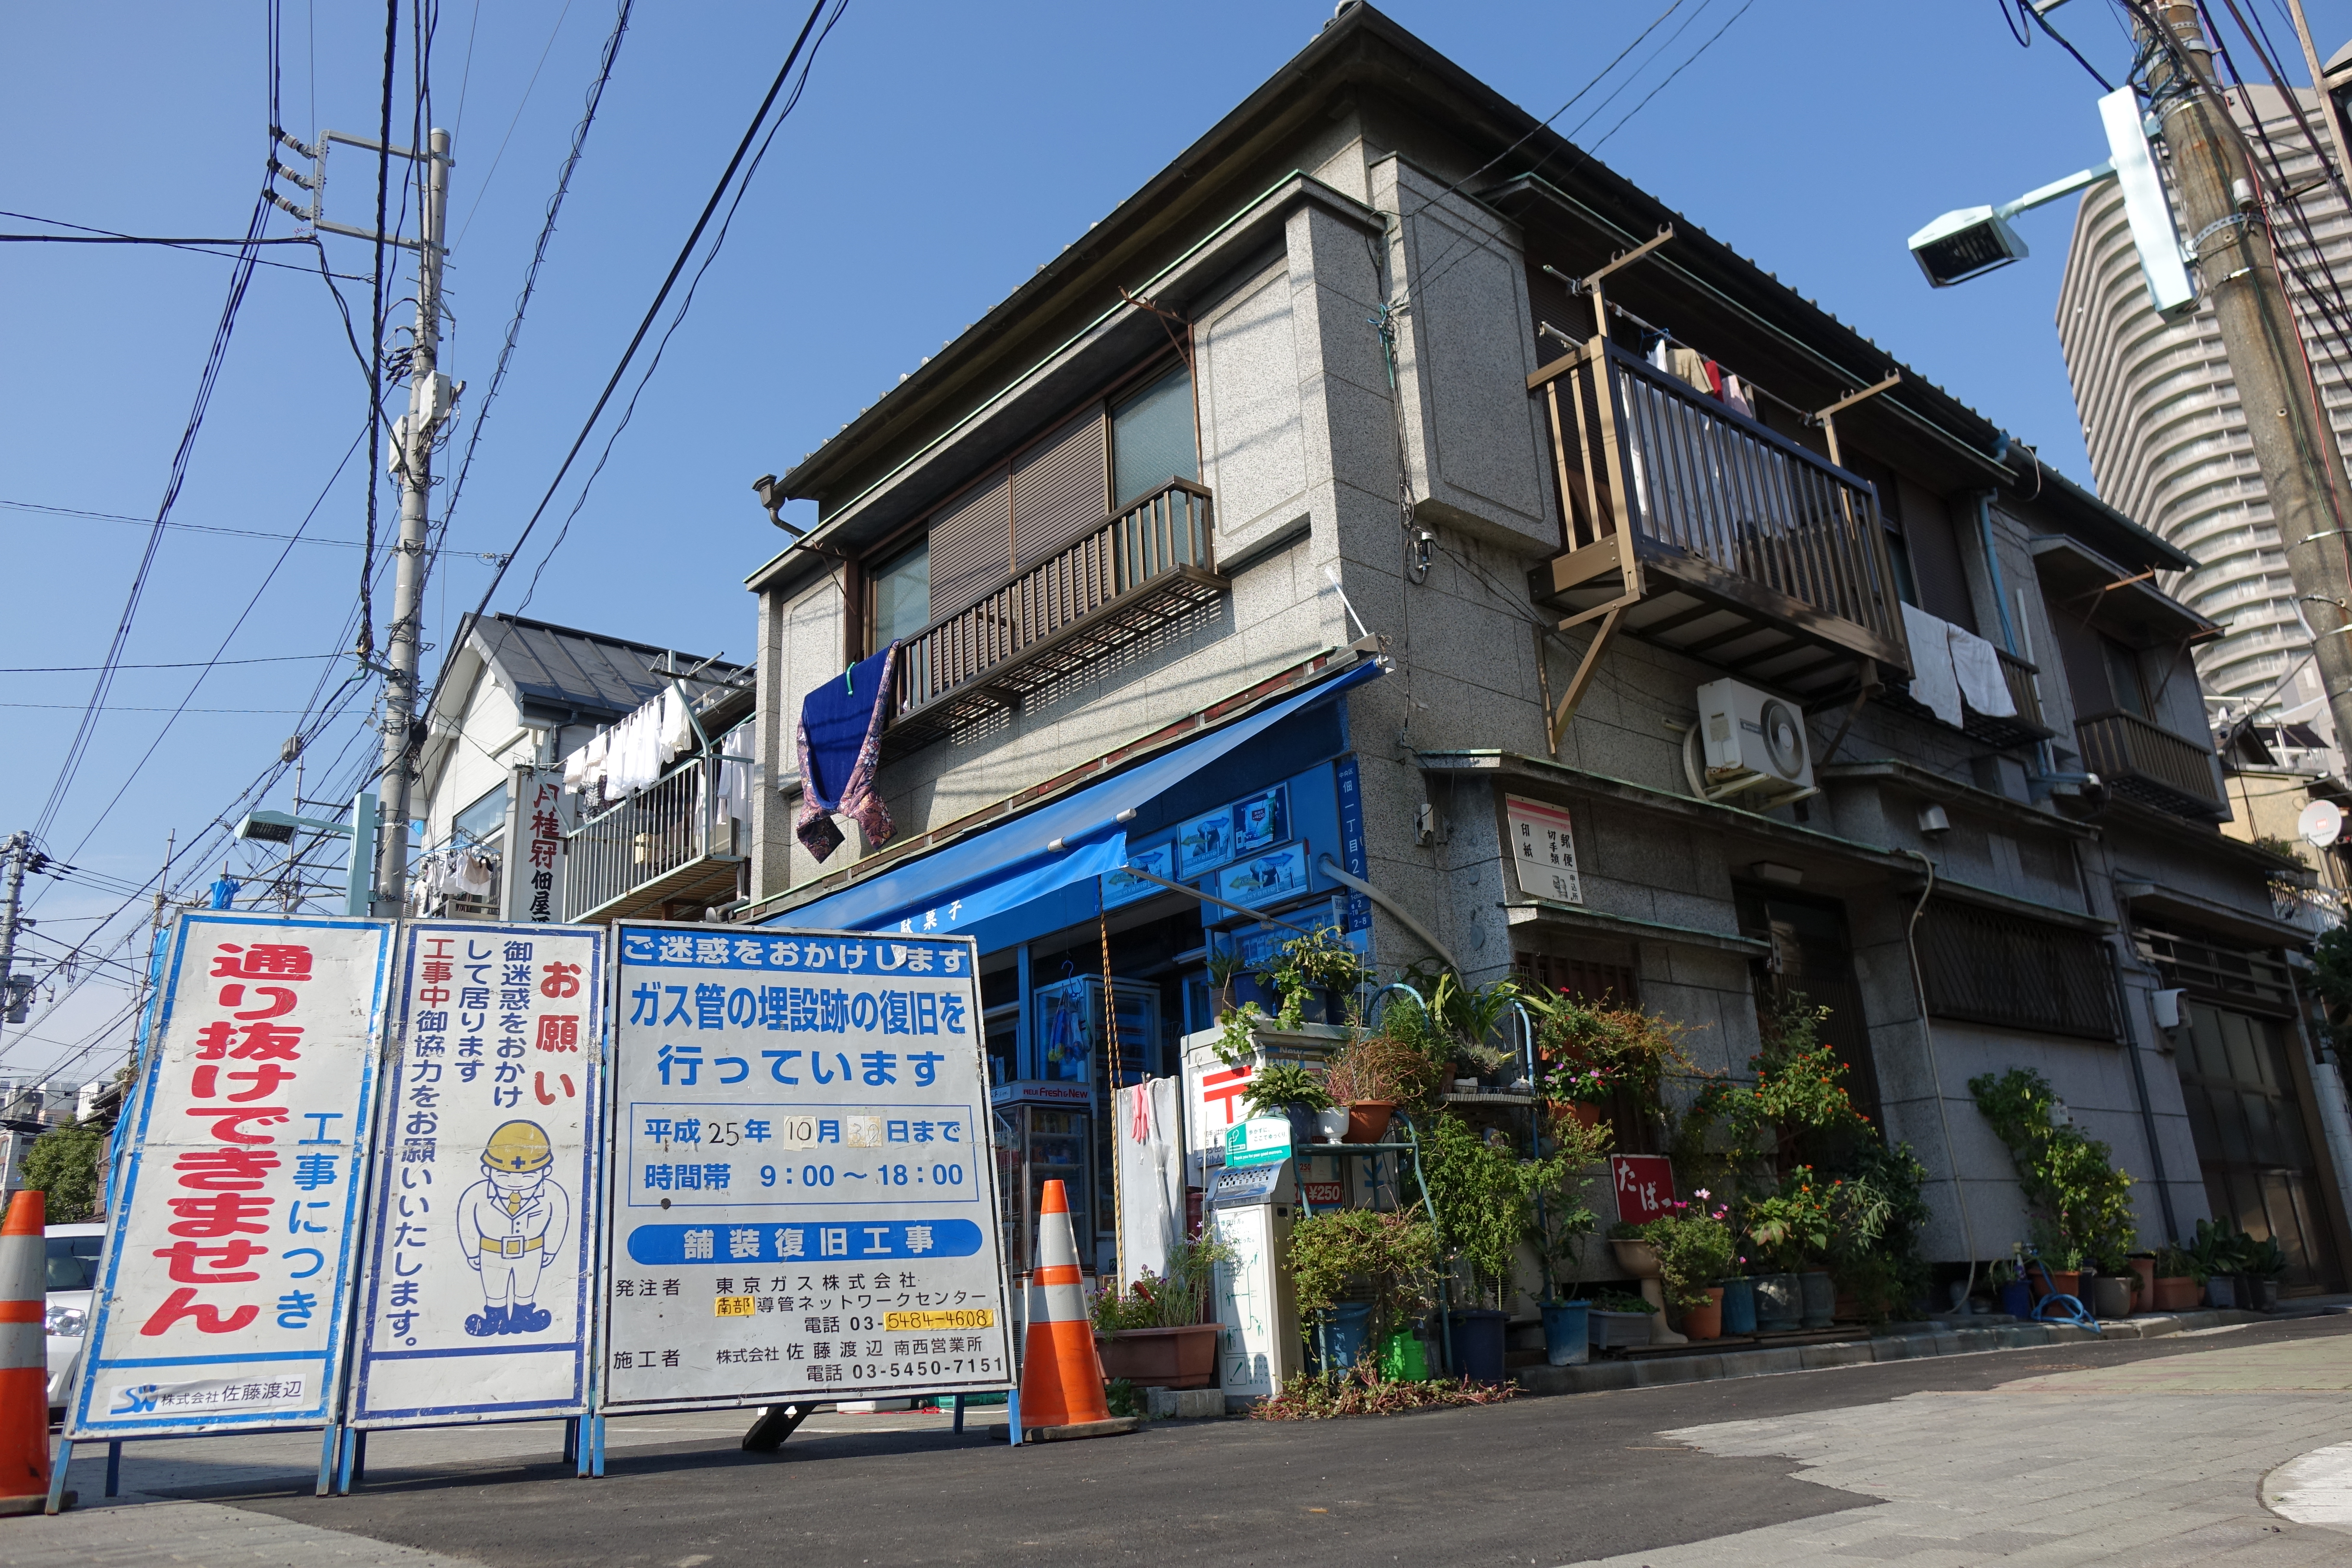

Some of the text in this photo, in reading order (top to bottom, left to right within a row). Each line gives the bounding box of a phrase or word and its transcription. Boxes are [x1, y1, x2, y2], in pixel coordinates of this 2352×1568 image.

[1339, 768, 1353, 778] 中央区
[529, 783, 560, 870] 月桂冠
[1520, 823, 1533, 858] 印紙
[1193, 851, 1217, 862] HYBRID
[1547, 830, 1560, 865] 切手類
[1560, 833, 1574, 868] 郵便
[1123, 882, 1148, 895] HYBRID
[1248, 887, 1275, 899] HYBRID
[1569, 874, 1578, 901] 申込所
[900, 899, 962, 934] 駄菓子
[1354, 917, 1367, 928] 2-8
[625, 935, 967, 973] ご迷惑をおかけします
[454, 939, 493, 1083] して居ります
[494, 940, 533, 1109] 御迷惑をおかけ
[630, 981, 966, 1035] ガス管の埋設跡の復旧を
[534, 961, 582, 1106] お願い
[658, 1044, 945, 1087] 行っています
[140, 943, 313, 1336] 通り抜けできません
[645, 1163, 731, 1190] 時間帯
[1309, 1185, 1340, 1200] ¥250
[276, 1113, 344, 1329] 工事につき
[684, 1225, 933, 1259] 舗装復旧工事
[616, 1271, 916, 1297] 発注者 東京ガス株式会社
[805, 1316, 840, 1333] 電話
[614, 1349, 680, 1369] 施工者
[806, 1363, 842, 1382] 電話
